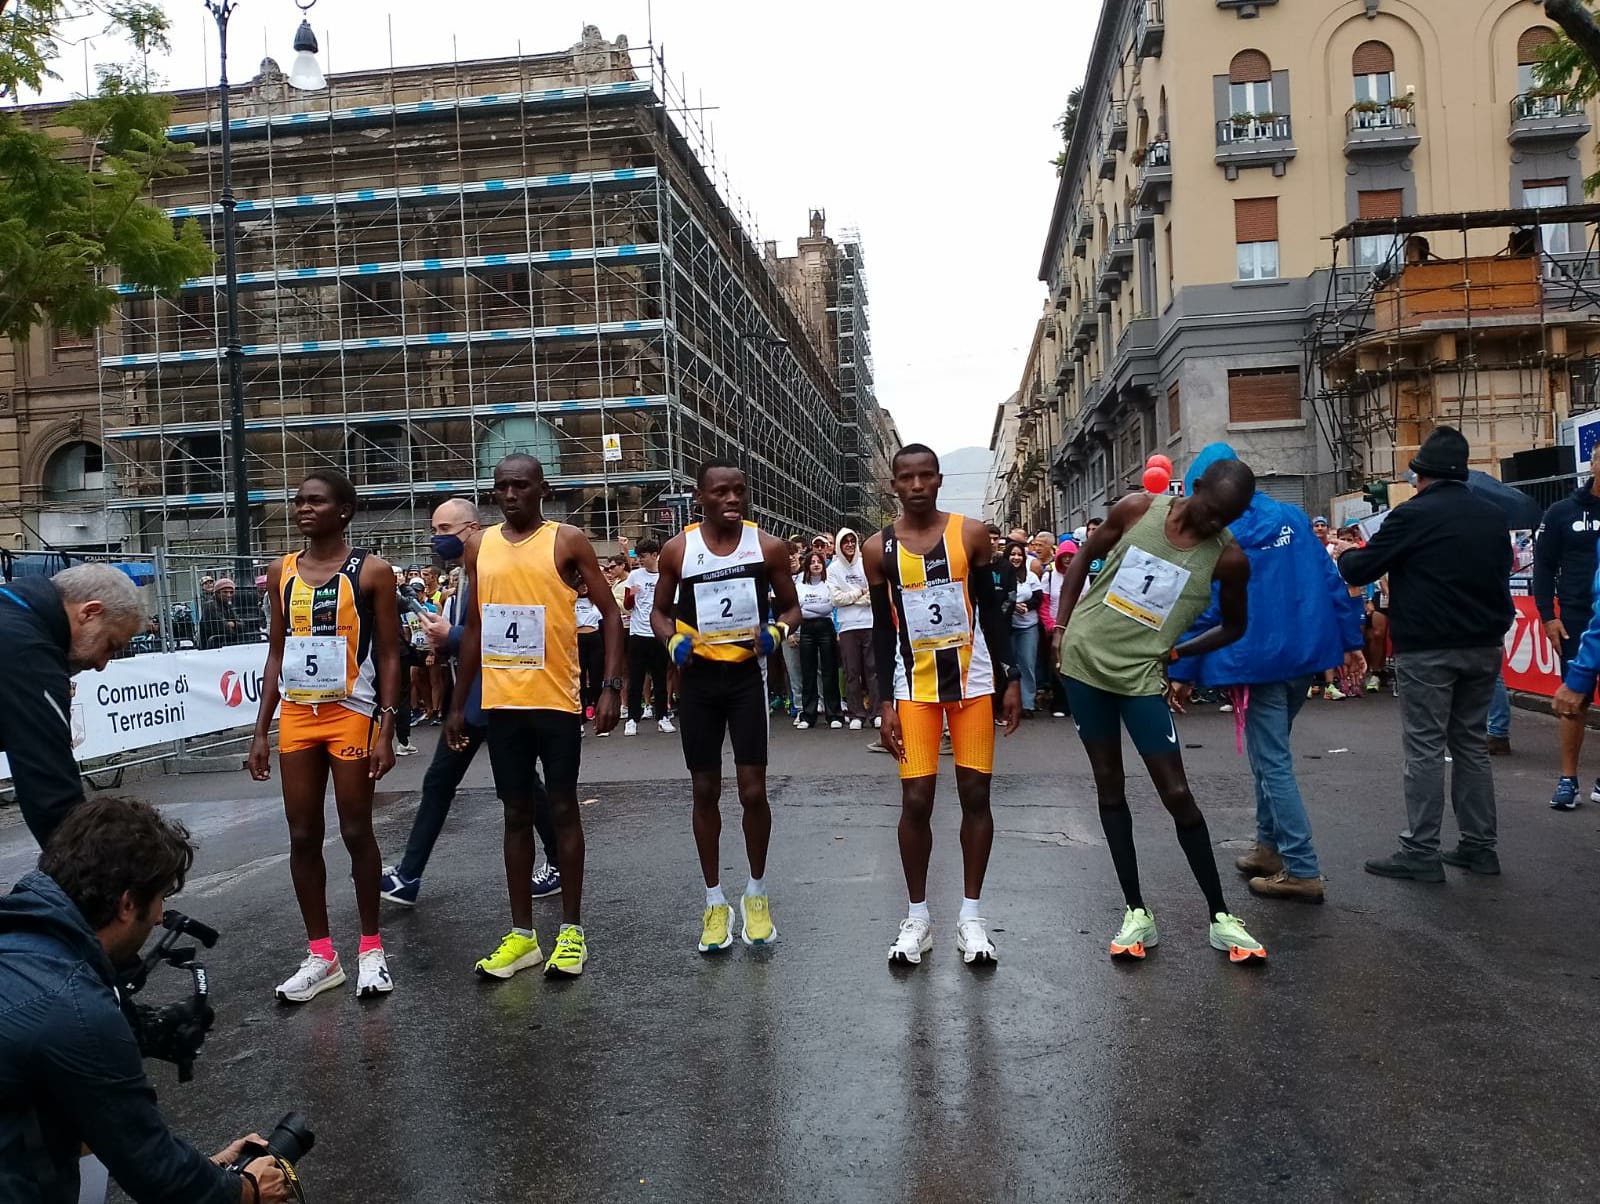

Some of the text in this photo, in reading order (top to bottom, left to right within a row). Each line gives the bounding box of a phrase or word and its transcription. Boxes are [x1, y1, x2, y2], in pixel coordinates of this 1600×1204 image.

[1142, 575, 1155, 595] 1
[720, 598, 733, 618] 2
[928, 604, 943, 625] 3
[505, 622, 519, 643] 4
[305, 654, 318, 676] 5
[97, 674, 189, 706] Comune di
[107, 701, 185, 733] Terrasini
